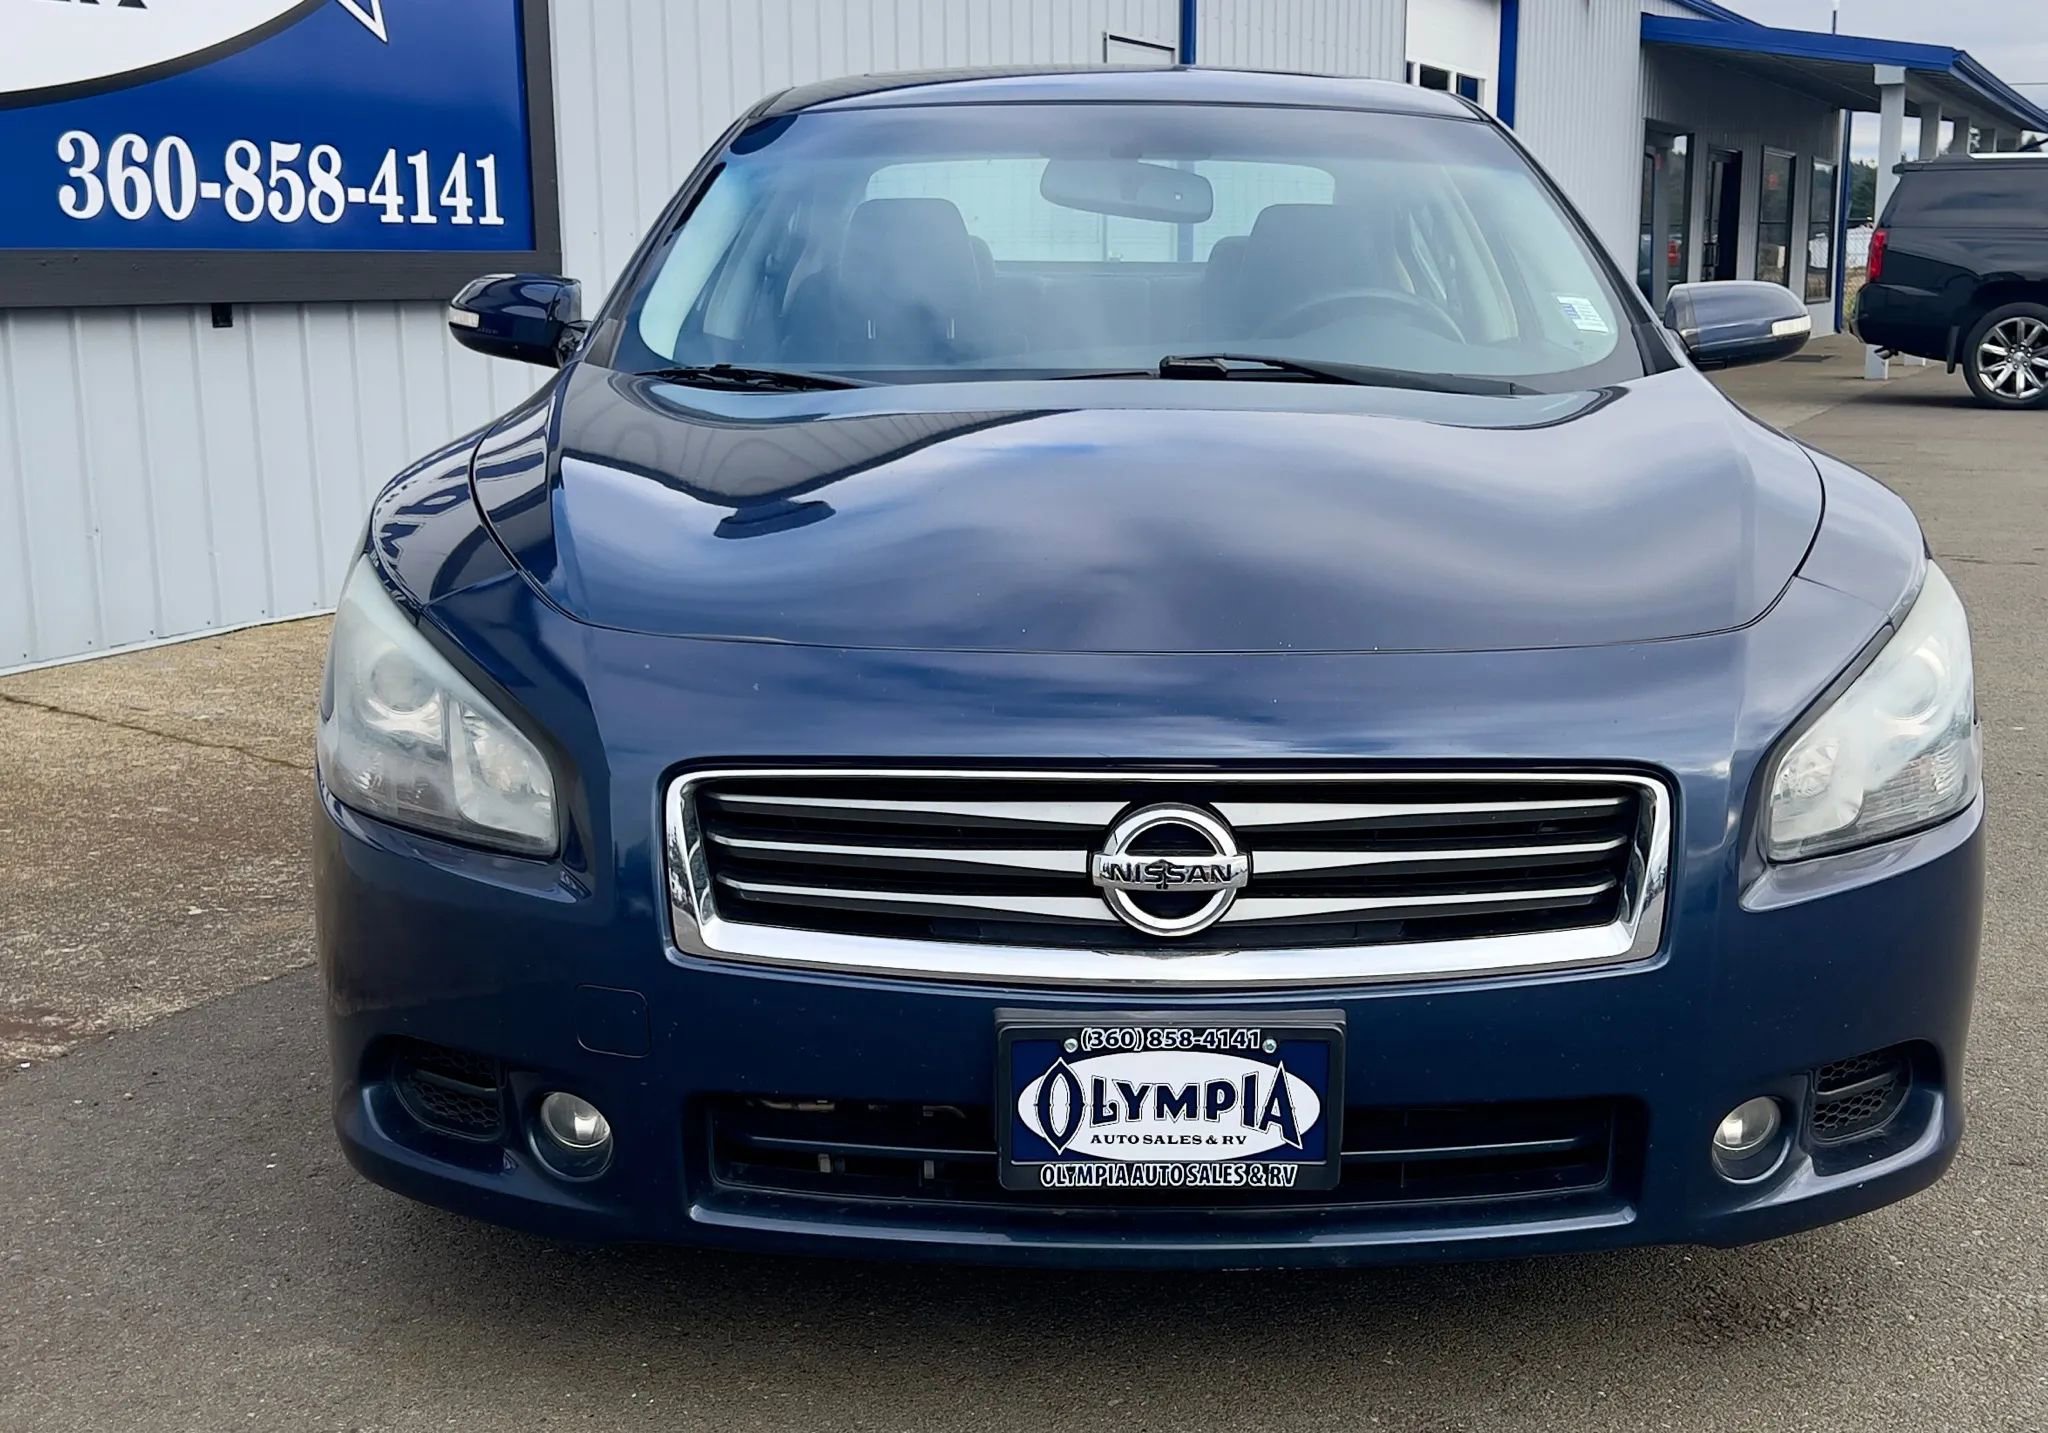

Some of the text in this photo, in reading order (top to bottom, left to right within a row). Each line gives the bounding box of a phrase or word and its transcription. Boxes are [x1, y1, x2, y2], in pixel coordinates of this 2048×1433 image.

[56, 130, 505, 226] 360-858-4141
[1108, 862, 1232, 884] NISSAN
[1081, 1028, 1261, 1051] (360) 858-4141
[1036, 1057, 1303, 1155] OLYMPIA
[1090, 1134, 1247, 1145] AUTO SALES & RV
[1040, 1163, 1298, 1187] OLYMPIA AUTO SALES & RV
